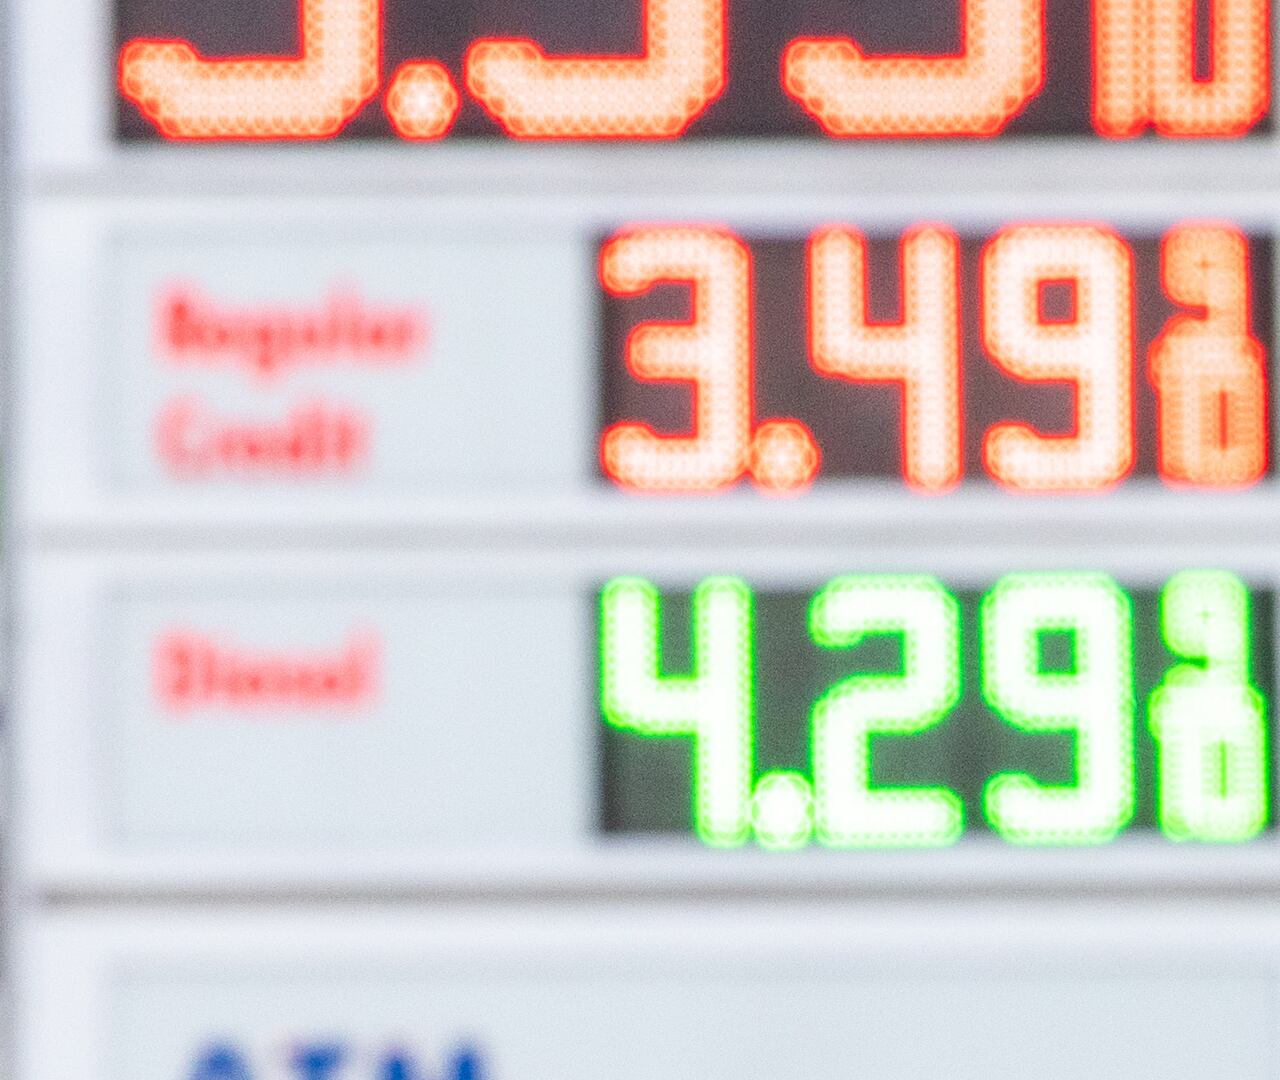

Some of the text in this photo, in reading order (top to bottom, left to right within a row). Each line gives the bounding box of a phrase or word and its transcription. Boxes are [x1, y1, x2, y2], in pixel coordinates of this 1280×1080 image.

[154, 283, 428, 377] Regular
[598, 219, 1137, 497] 3.49
[154, 399, 370, 476] Credit
[598, 571, 1137, 852] 4.29
